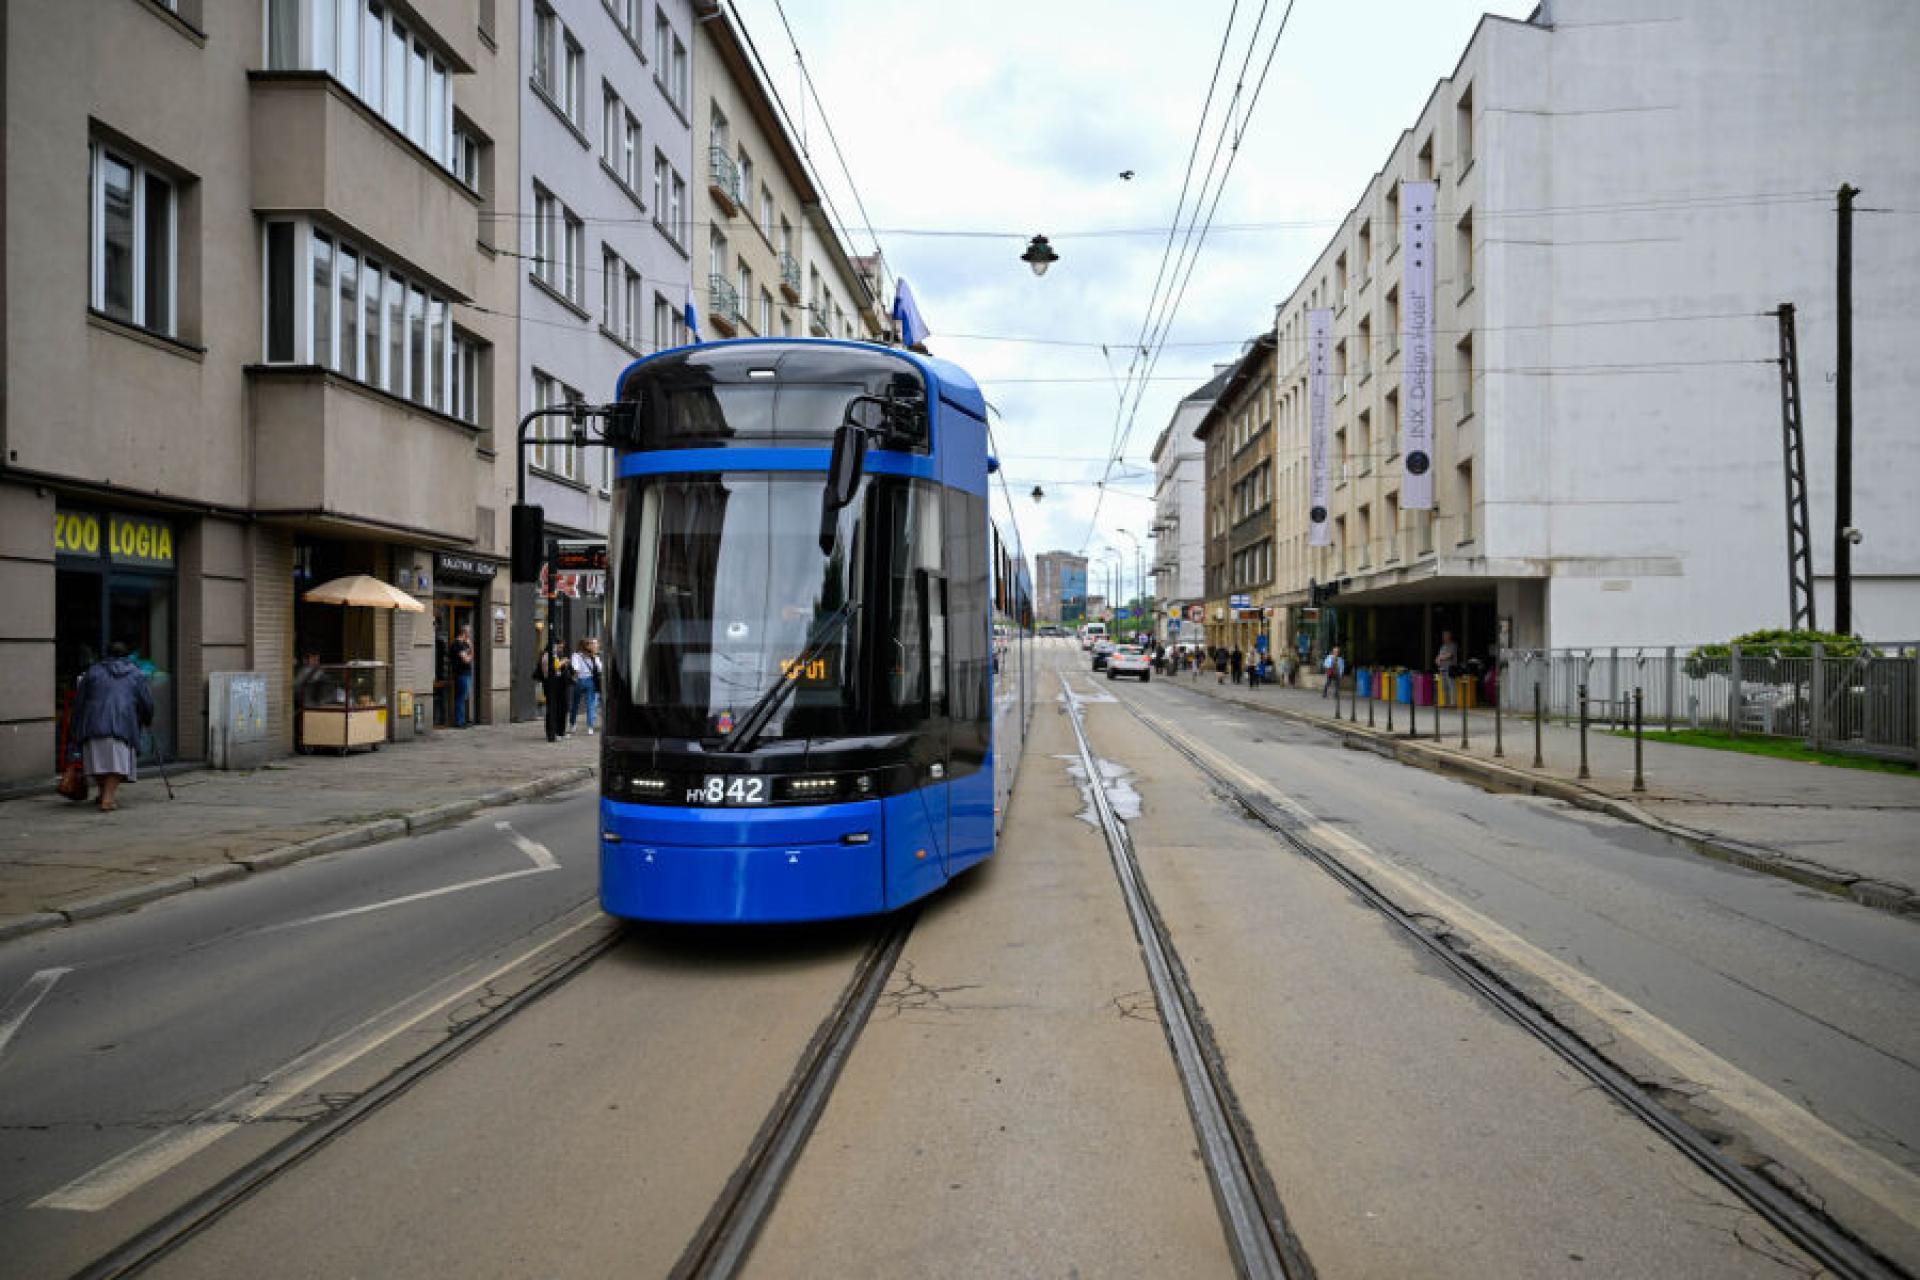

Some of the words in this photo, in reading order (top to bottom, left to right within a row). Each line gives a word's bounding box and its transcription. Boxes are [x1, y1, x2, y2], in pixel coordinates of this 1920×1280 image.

[1410, 344, 1428, 400] Design
[55, 513, 99, 553] ZOO
[109, 518, 172, 561] LOGIA
